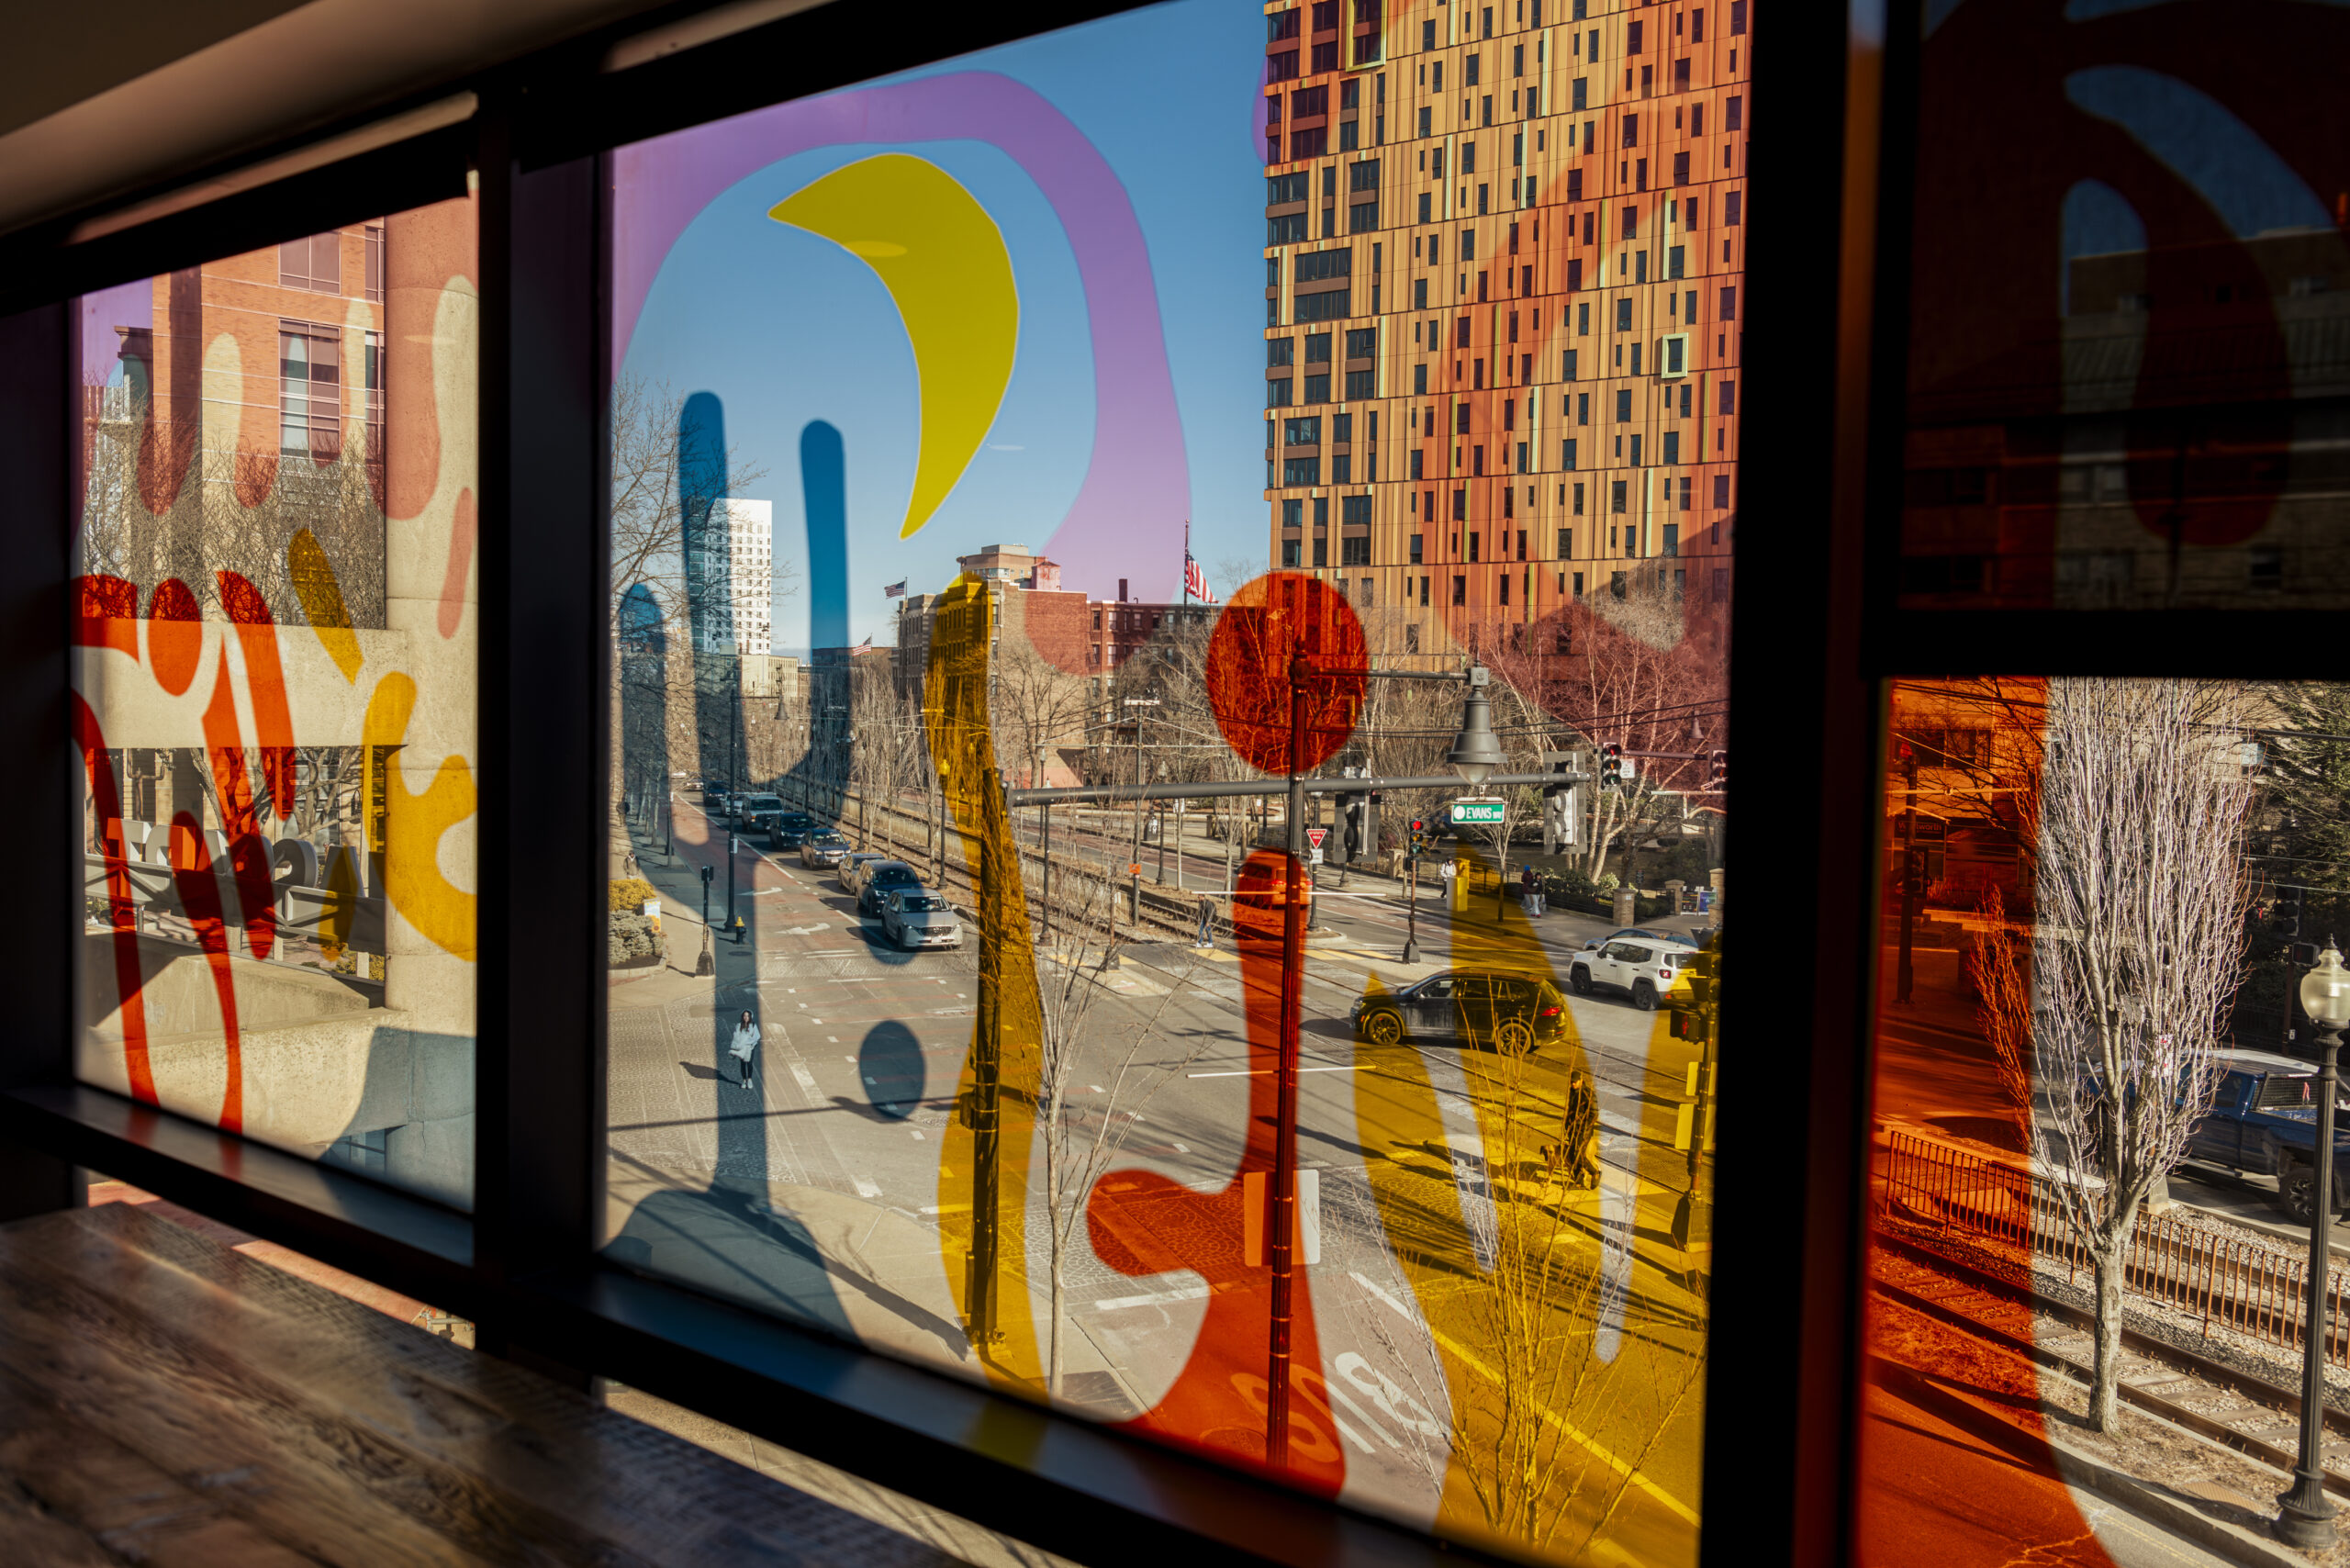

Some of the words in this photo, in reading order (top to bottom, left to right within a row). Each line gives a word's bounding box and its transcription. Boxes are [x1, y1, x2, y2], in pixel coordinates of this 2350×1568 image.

[1466, 807, 1493, 819] EVANS
[1898, 822, 1942, 831] Wtworth
[1230, 1351, 1451, 1462] BUS
